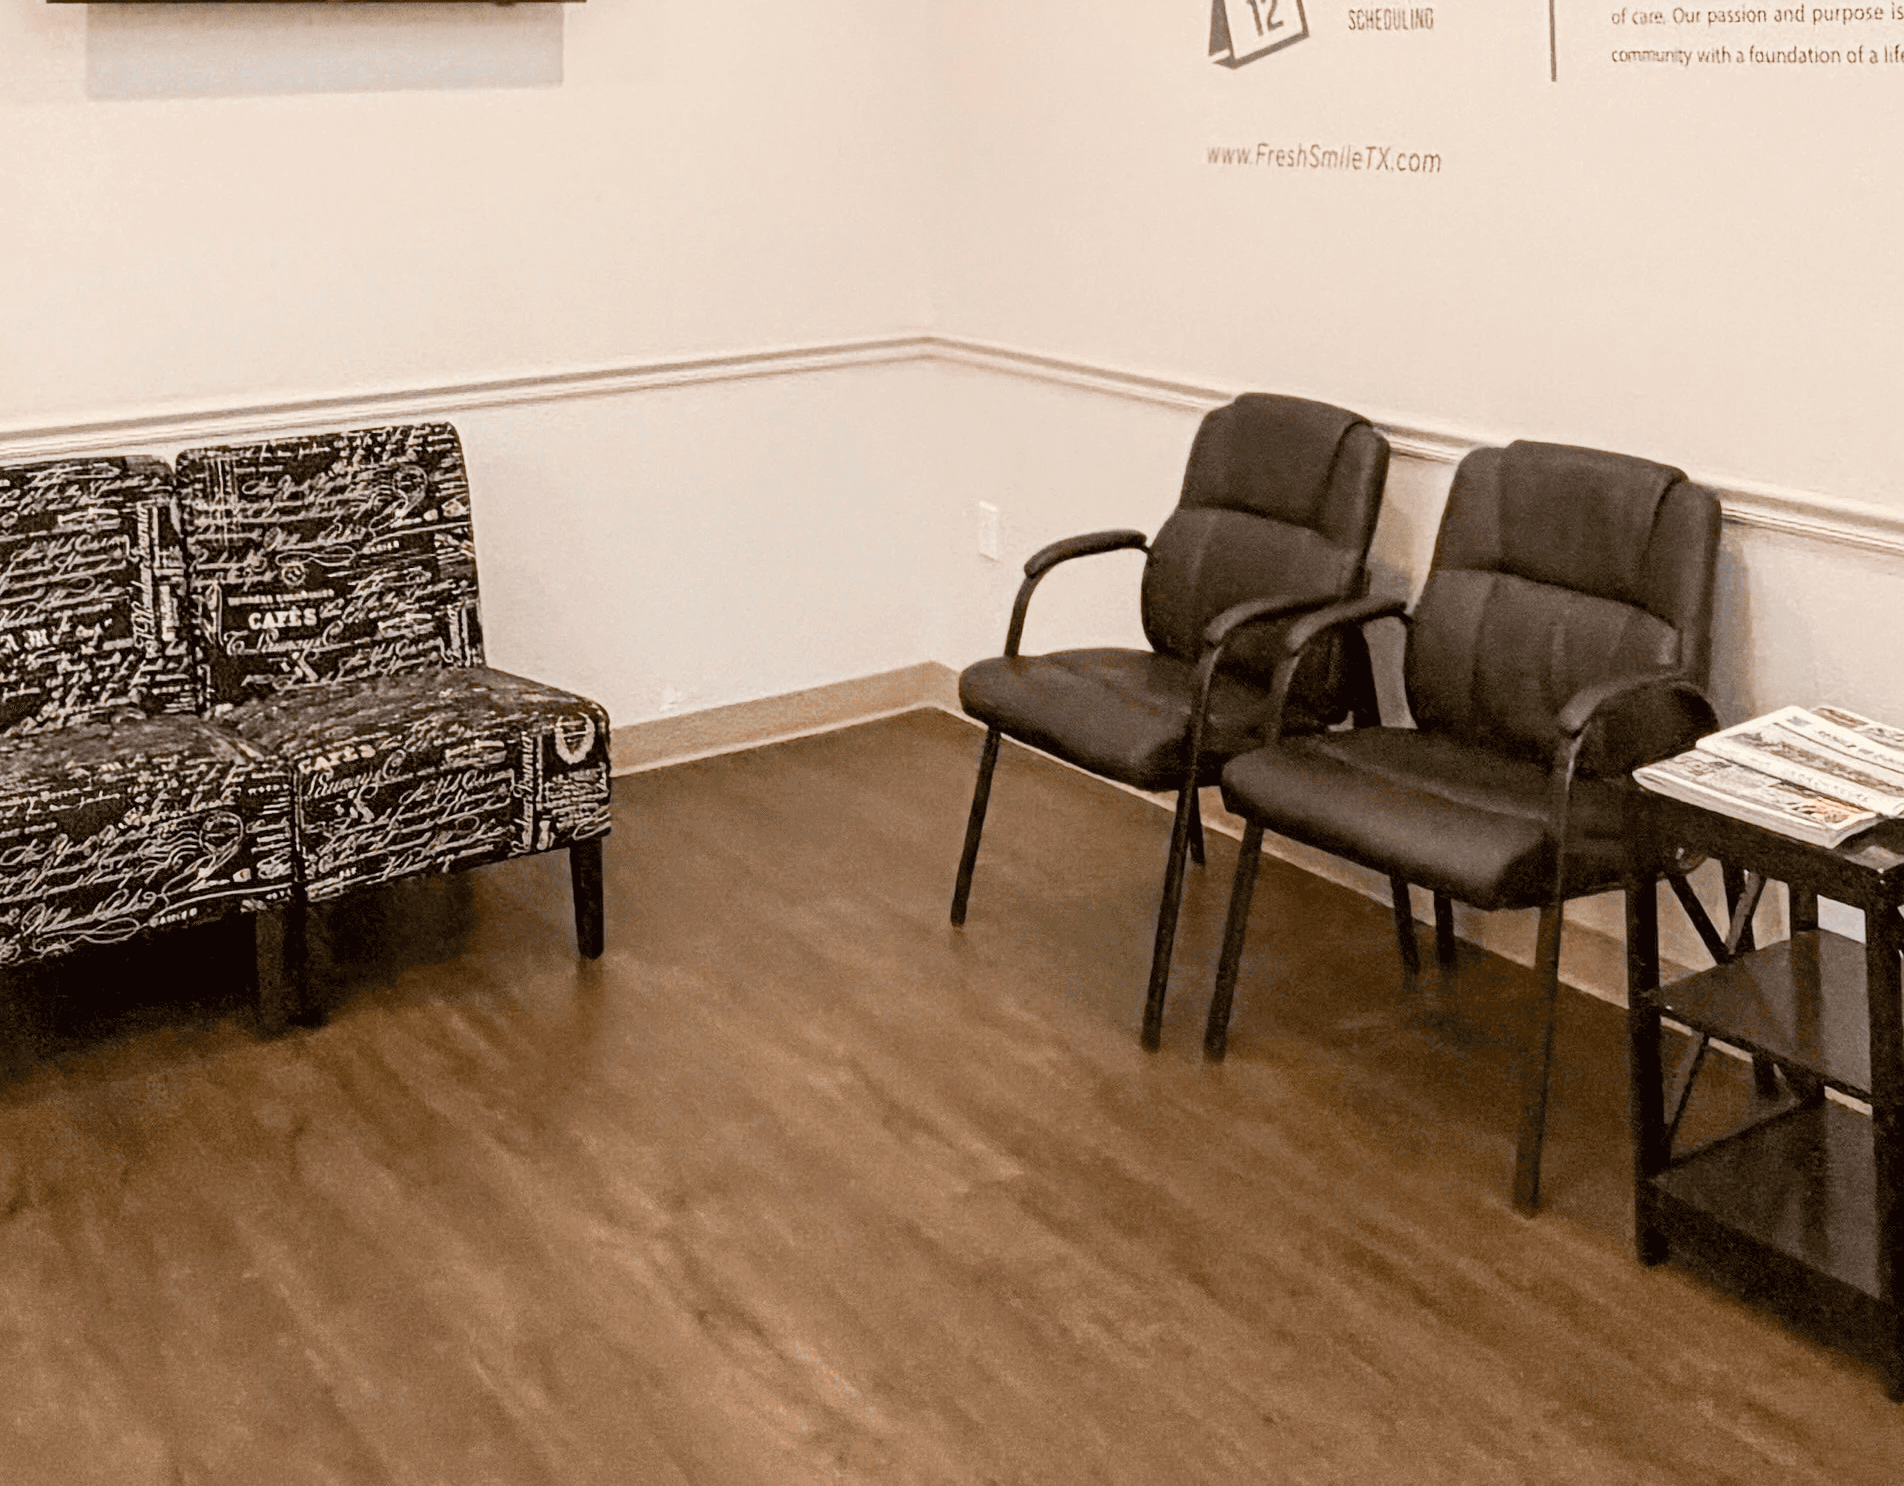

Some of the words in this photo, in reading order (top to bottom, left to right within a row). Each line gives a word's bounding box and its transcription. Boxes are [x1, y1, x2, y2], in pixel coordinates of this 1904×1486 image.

[1347, 7, 1435, 32] SCHEDULING
[1610, 6, 1627, 26] of
[1672, 6, 1701, 25] Our
[1707, 9, 1768, 27] passion
[1773, 3, 1805, 23] and
[1812, 6, 1885, 26] purpose
[1891, 1, 1904, 21] is
[1610, 49, 1693, 68] community
[1697, 45, 1732, 65] with
[1735, 50, 1746, 64] a
[1748, 44, 1842, 65] foundation
[1846, 44, 1864, 65] of
[1868, 49, 1879, 65] a
[1207, 141, 1443, 174] www.FreshSmileTX.com
